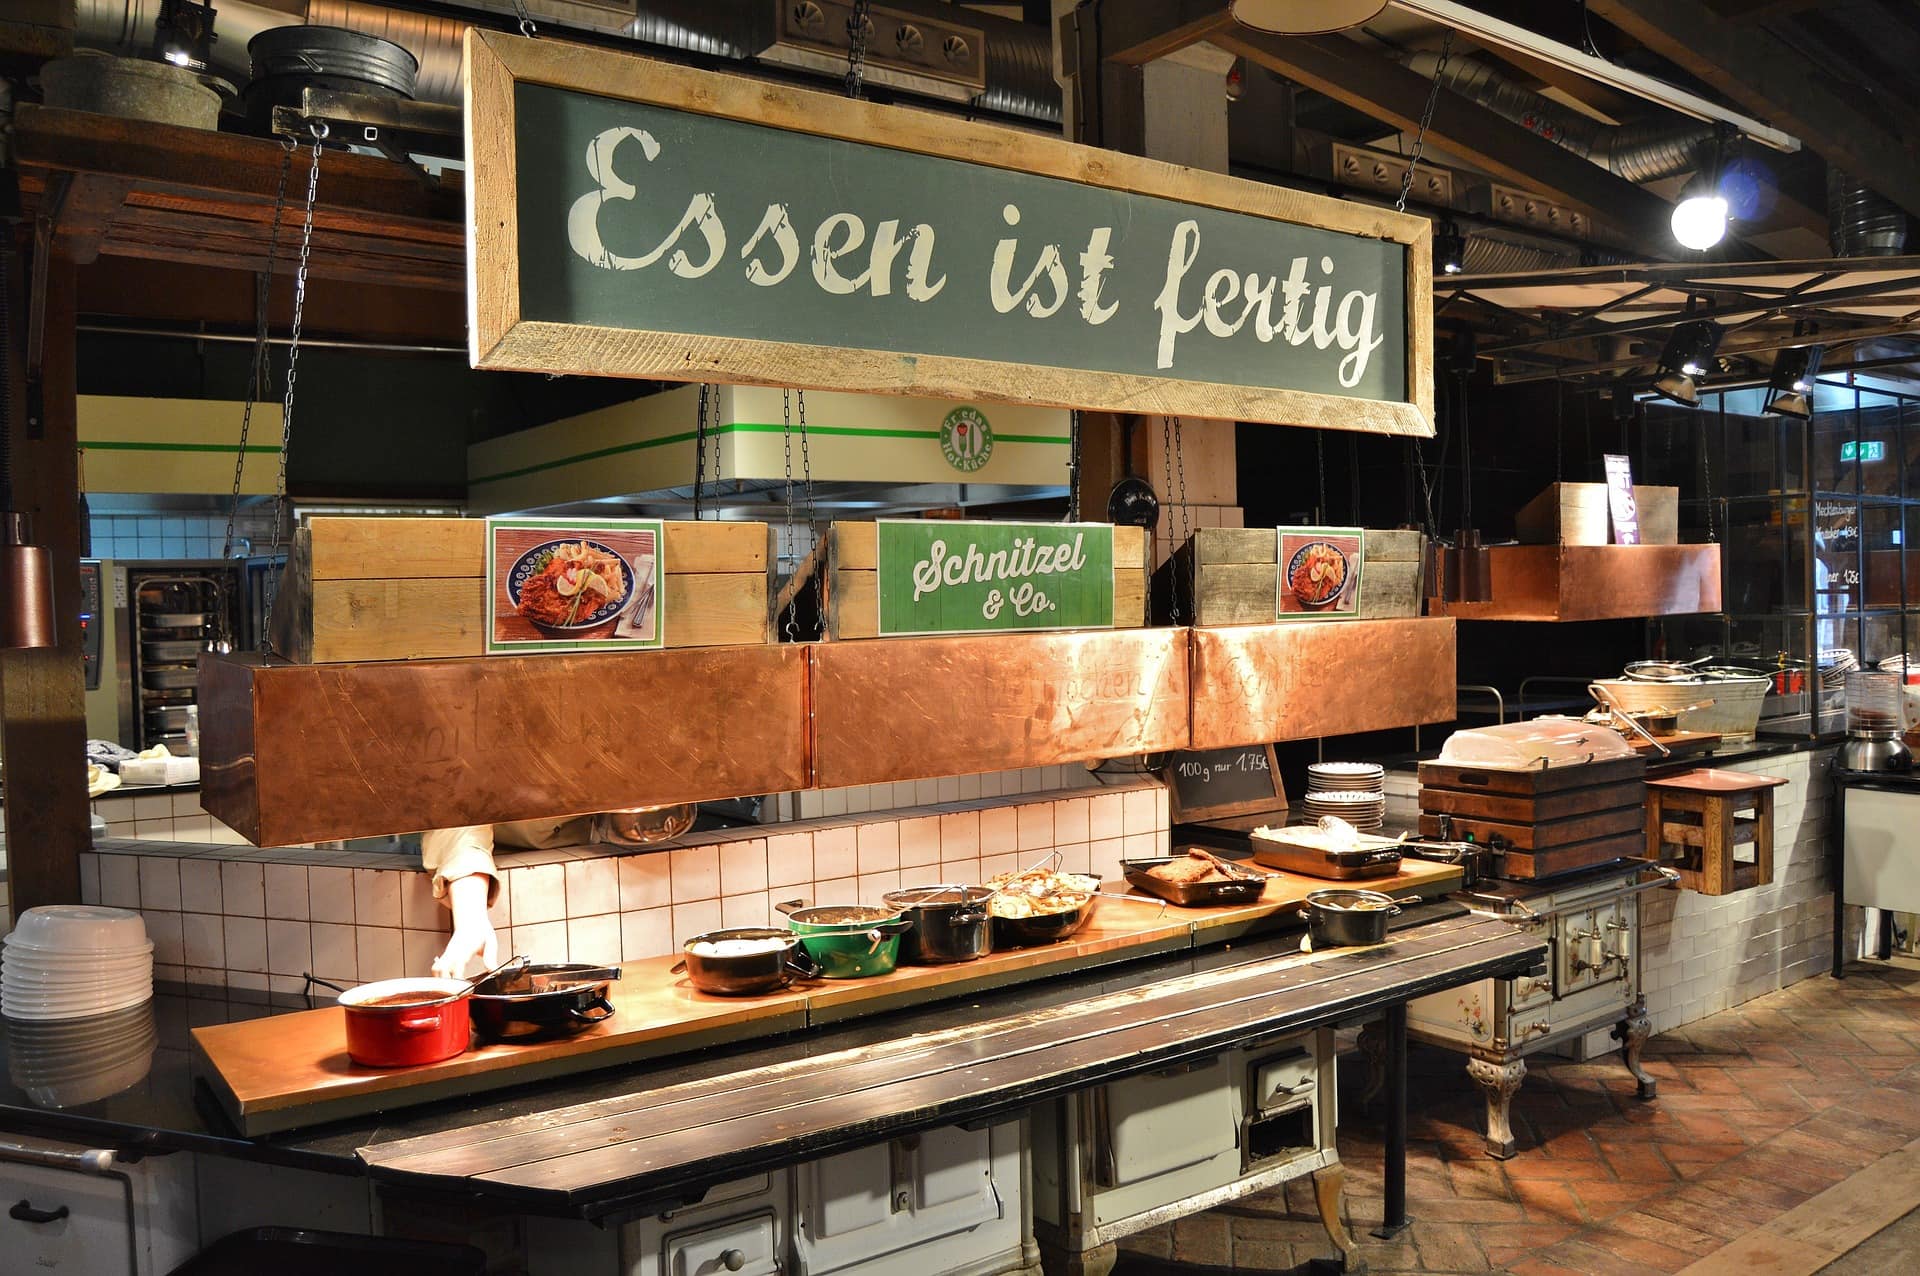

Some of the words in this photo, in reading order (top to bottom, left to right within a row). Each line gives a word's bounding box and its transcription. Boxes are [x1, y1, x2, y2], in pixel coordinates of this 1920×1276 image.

[568, 126, 947, 302] Essen
[991, 205, 1120, 324] ist
[1154, 220, 1384, 388] fertig
[913, 533, 1086, 602] Schnitzel
[983, 589, 1004, 620] &
[1010, 583, 1056, 617] Co.
[1214, 763, 1232, 772] nur
